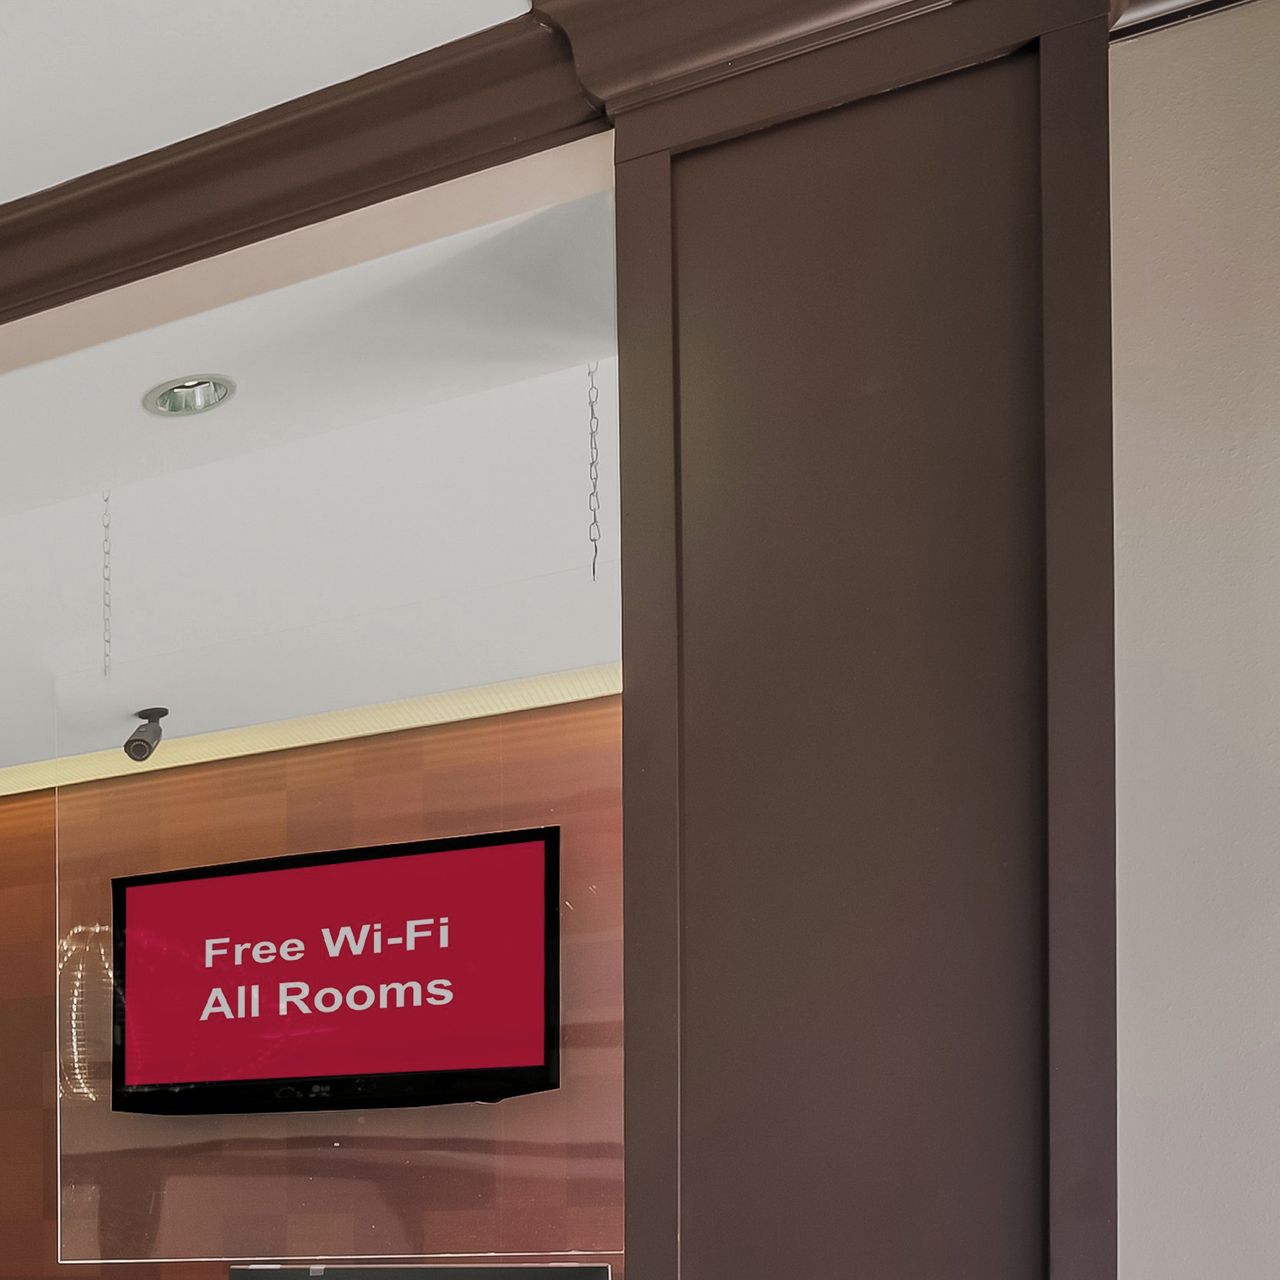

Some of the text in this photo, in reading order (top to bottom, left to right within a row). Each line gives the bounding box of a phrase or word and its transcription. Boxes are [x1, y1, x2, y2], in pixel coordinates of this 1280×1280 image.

[204, 917, 449, 968] Free Wi-Fi
[199, 979, 454, 1021] All Rooms
